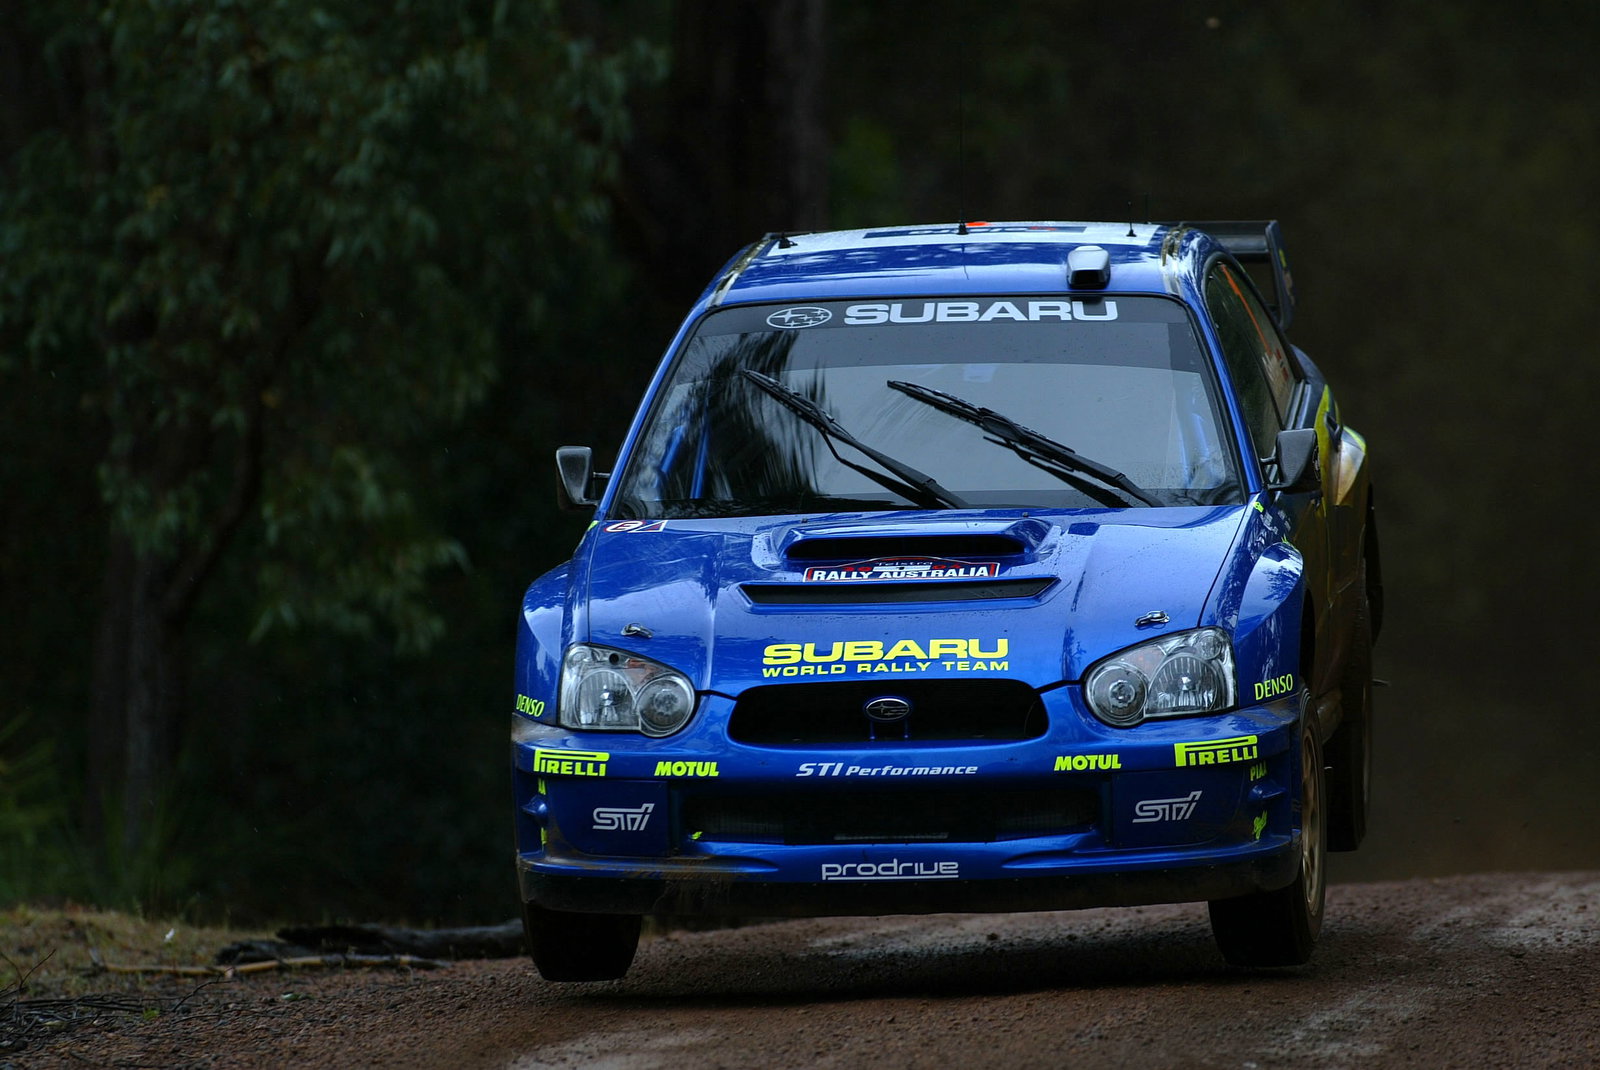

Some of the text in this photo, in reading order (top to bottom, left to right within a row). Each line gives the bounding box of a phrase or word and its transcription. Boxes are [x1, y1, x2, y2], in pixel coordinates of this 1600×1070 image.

[843, 300, 1119, 325] SUBARU
[811, 566, 989, 582] RALLY AUSTRALIA
[762, 638, 1009, 665] SUBARU
[762, 660, 1009, 678] WORLD RALLY TEAM
[1254, 673, 1294, 701] DENSO
[515, 693, 546, 718] DENSO
[533, 748, 611, 777] PIRELLI
[1053, 753, 1122, 771] MOTUL
[1173, 734, 1258, 768] PIRELLI
[653, 760, 720, 778] MOTUL
[795, 762, 979, 777] STI Performance
[821, 858, 960, 881] prodrive
